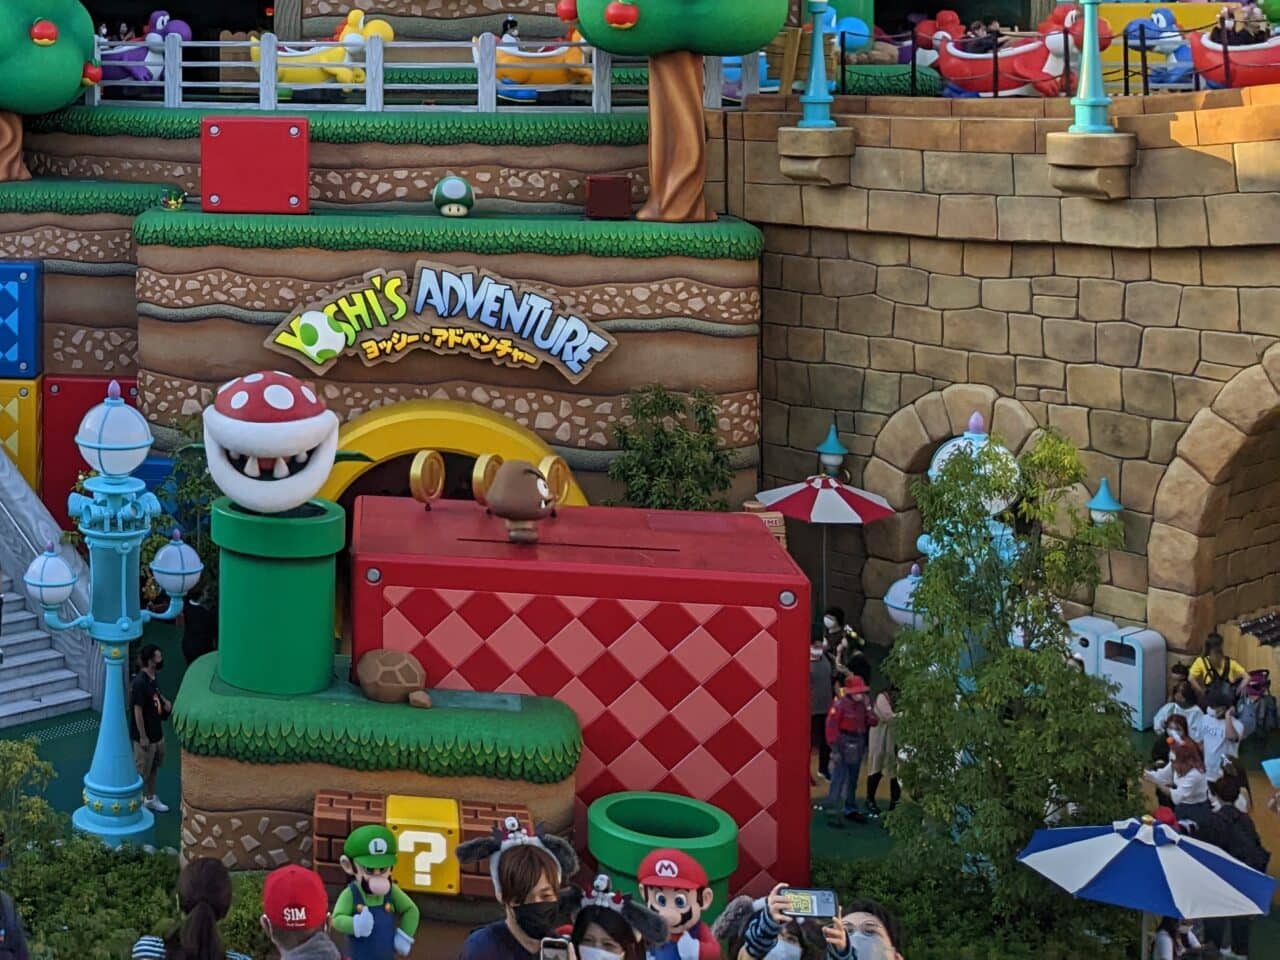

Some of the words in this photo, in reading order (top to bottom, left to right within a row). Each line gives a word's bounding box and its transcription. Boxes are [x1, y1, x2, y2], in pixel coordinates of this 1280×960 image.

[273, 275, 408, 366] YOSHI'S
[414, 266, 609, 375] ADVENTURE
[658, 861, 676, 876] M
